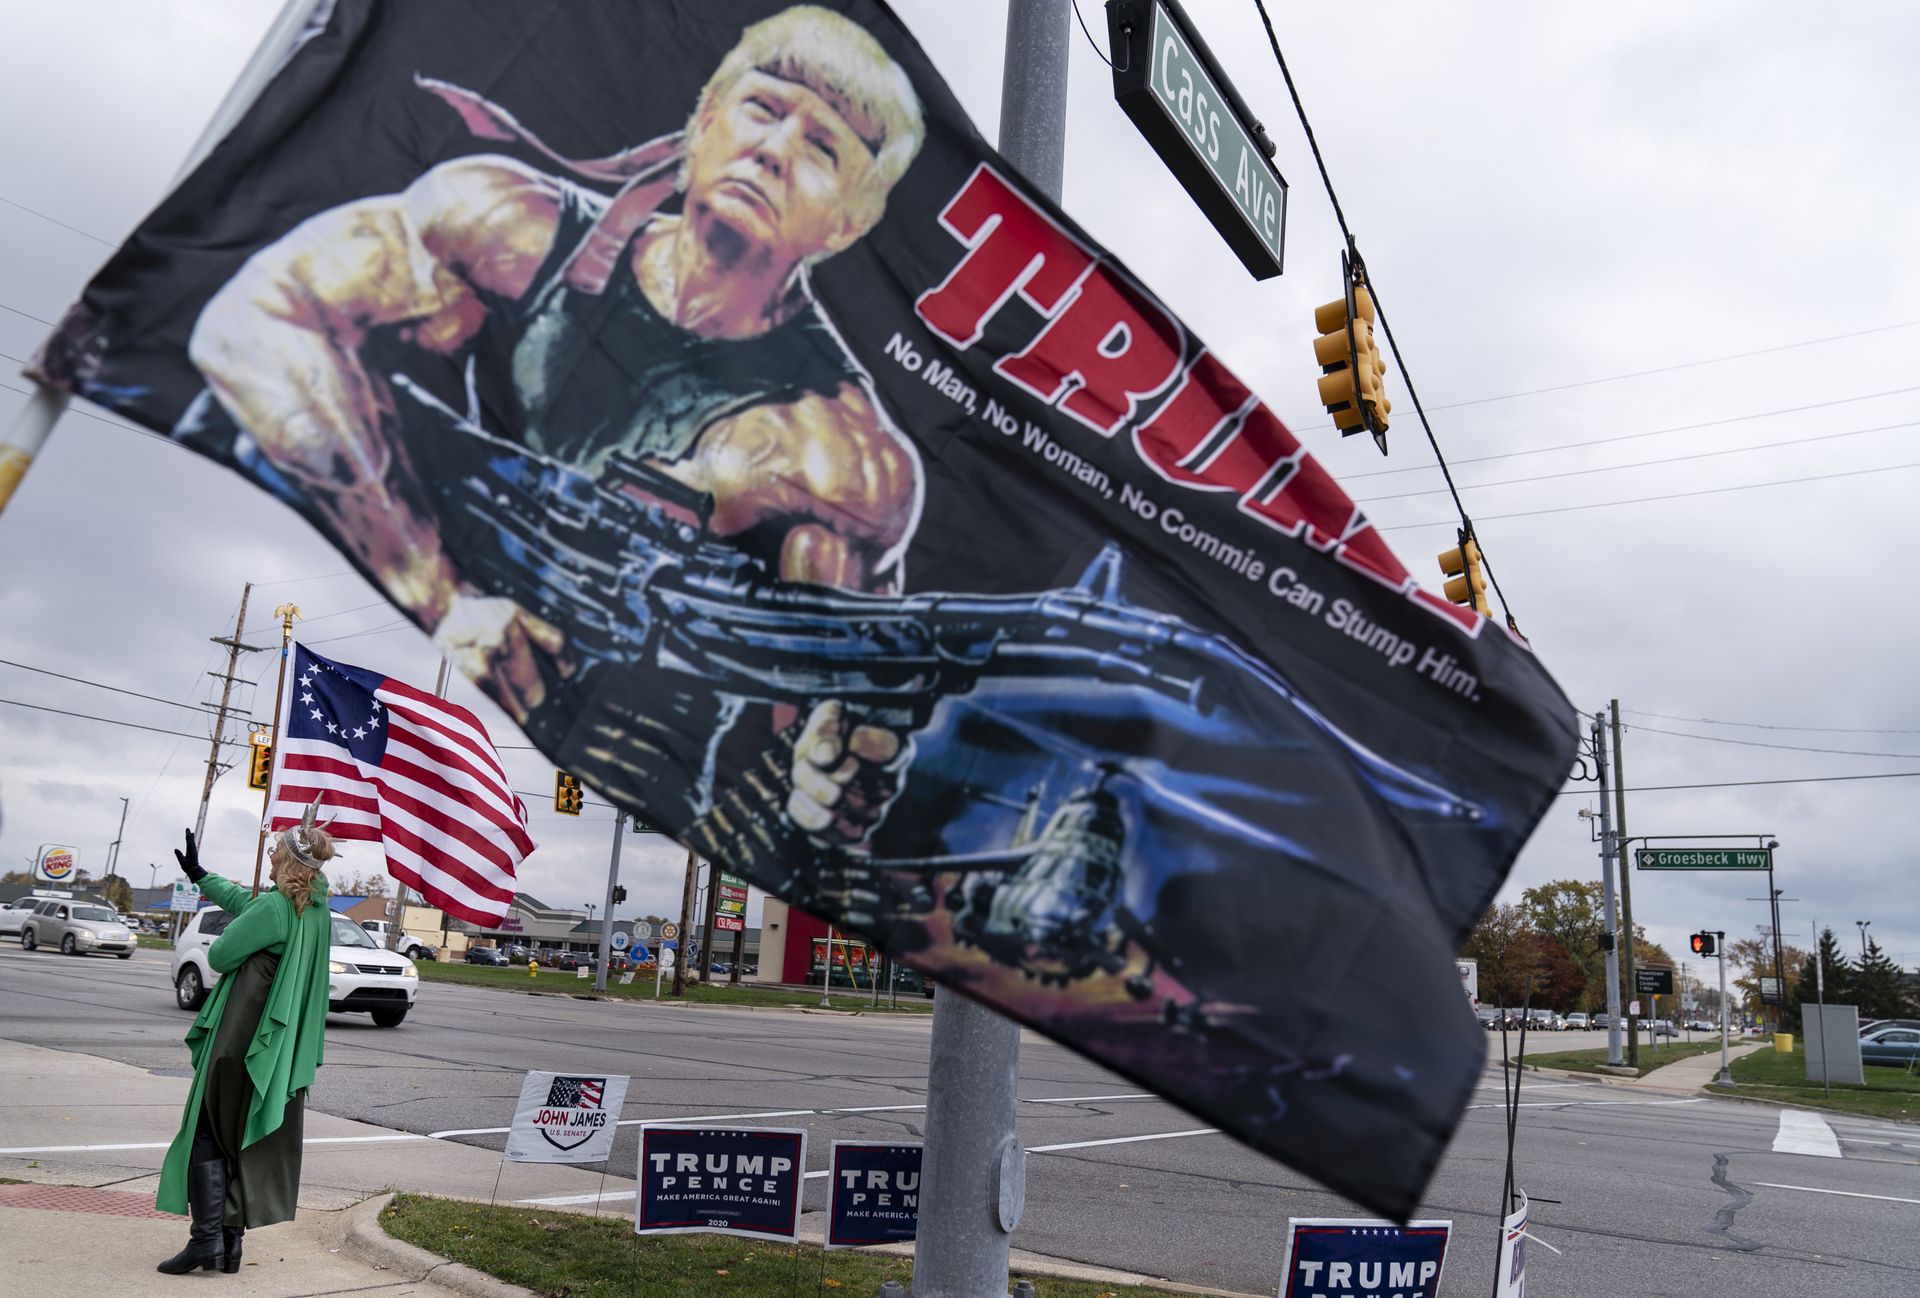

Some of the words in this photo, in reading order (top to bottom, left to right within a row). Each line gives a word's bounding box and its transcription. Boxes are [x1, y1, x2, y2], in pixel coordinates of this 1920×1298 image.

[1162, 36, 1220, 162] Cass
[1235, 145, 1275, 240] Ave
[915, 161, 1485, 639] TRUM
[884, 332, 922, 371] No
[921, 359, 977, 415] Man,
[982, 398, 1019, 436] No
[1021, 421, 1114, 499] Woman,
[1119, 483, 1157, 520] No
[1160, 508, 1265, 581] Commie
[1268, 567, 1326, 616] Can
[1325, 599, 1416, 667] Stump
[1416, 648, 1481, 702] Him.
[46, 860, 72, 870] KING
[1658, 852, 1729, 865] Groesbeck
[1737, 852, 1766, 867] Hwy
[721, 900, 744, 912] SUBWAY
[718, 917, 726, 928] CSL
[727, 918, 742, 931] Plasma
[533, 1110, 569, 1126] JOHN
[570, 1112, 607, 1127] JAMES
[563, 1129, 587, 1137] SENATE
[650, 1153, 792, 1177] TRUMP
[662, 1176, 777, 1194] PENCE
[841, 1169, 919, 1191] TRU
[682, 1193, 720, 1201] AMERICA
[723, 1194, 750, 1203] GREAT
[752, 1197, 781, 1207] AGAIN!
[852, 1193, 917, 1207] PEN
[847, 1210, 870, 1218] MAKE
[872, 1211, 910, 1219] AMERICA
[708, 1219, 728, 1227] 2020
[1299, 1260, 1437, 1290] TRUMP
